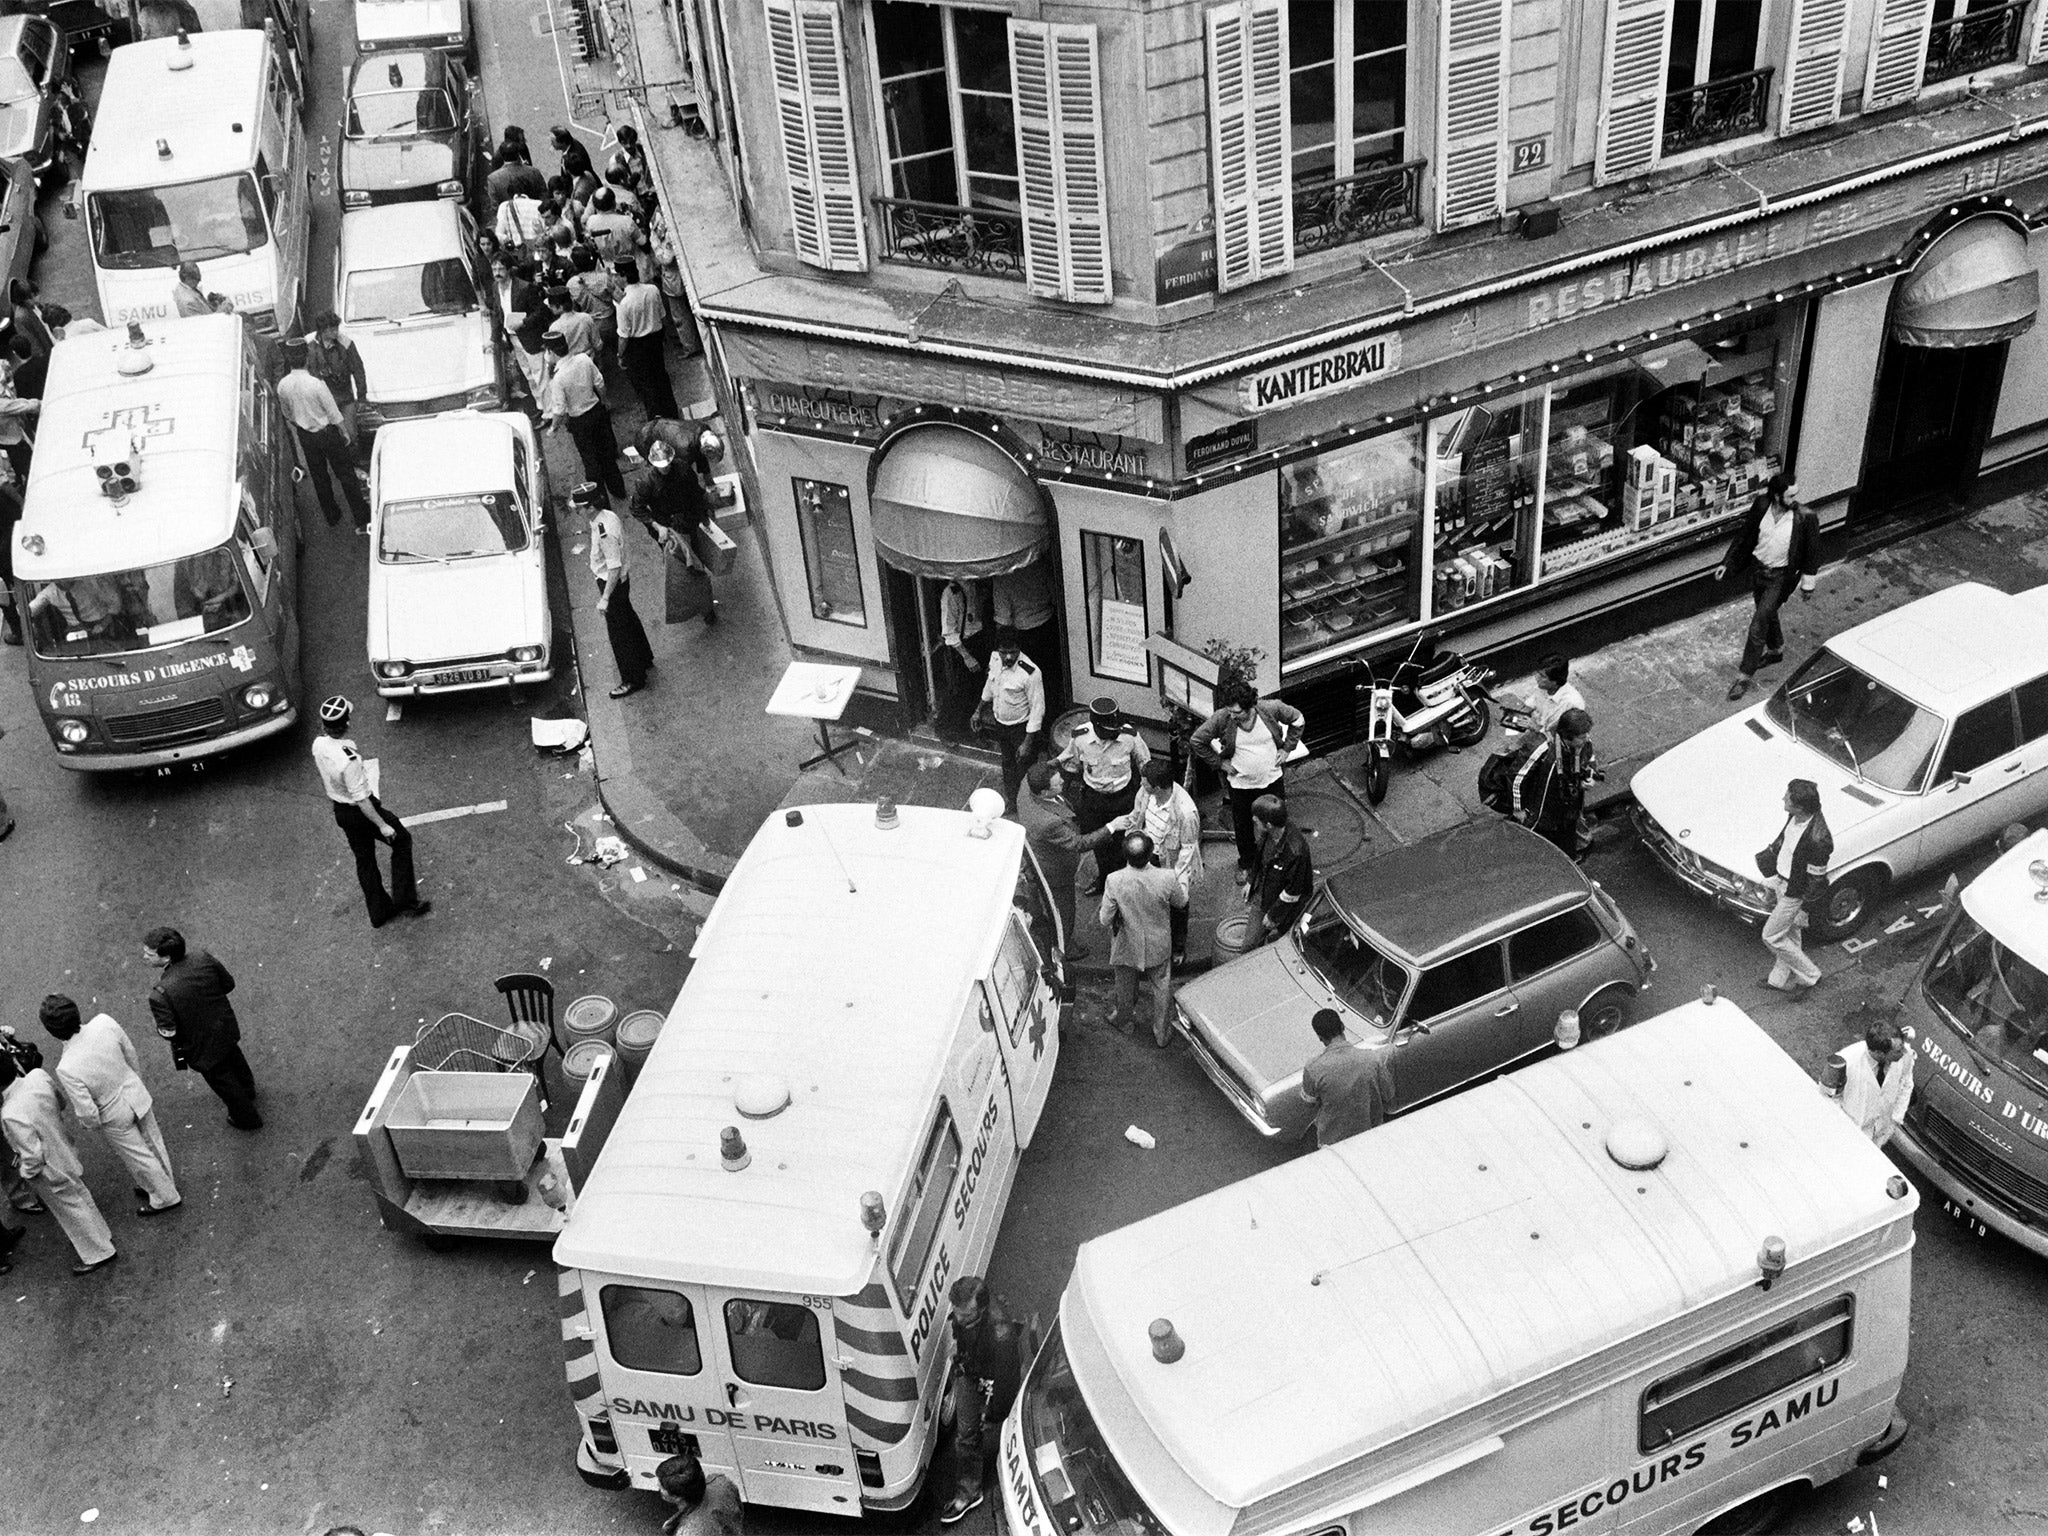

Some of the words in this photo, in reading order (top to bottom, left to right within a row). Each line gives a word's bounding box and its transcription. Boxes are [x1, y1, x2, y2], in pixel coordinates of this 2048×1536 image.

[1518, 142, 1542, 168] 22
[1201, 247, 1217, 261] RU
[118, 305, 168, 322] SAMU
[1256, 341, 1386, 407] KANTERBRÄU
[770, 392, 874, 428] CHARCUTERIE
[1039, 437, 1146, 477] RESTAURANT
[1193, 438, 1230, 459] FERDINAND
[1230, 432, 1251, 447] DUVAL
[1319, 498, 1379, 527] SADWICH
[68, 672, 141, 692] SECOURS
[143, 652, 229, 682] D'URGENCE
[62, 692, 81, 708] 18
[157, 767, 171, 777] AR
[192, 762, 205, 772] 21
[1921, 1037, 1995, 1104] SECOURS
[954, 1093, 999, 1232] SECOURS
[1943, 1200, 1961, 1219] AR
[1969, 1217, 1987, 1237] 19
[801, 1295, 833, 1310] 955
[910, 1242, 950, 1364] POLICE
[612, 1397, 696, 1422] SAMU
[704, 1408, 747, 1430] DE
[753, 1414, 838, 1441] PARIS
[1529, 1441, 1707, 1536] SECOURS
[1729, 1379, 1840, 1449] SAMU
